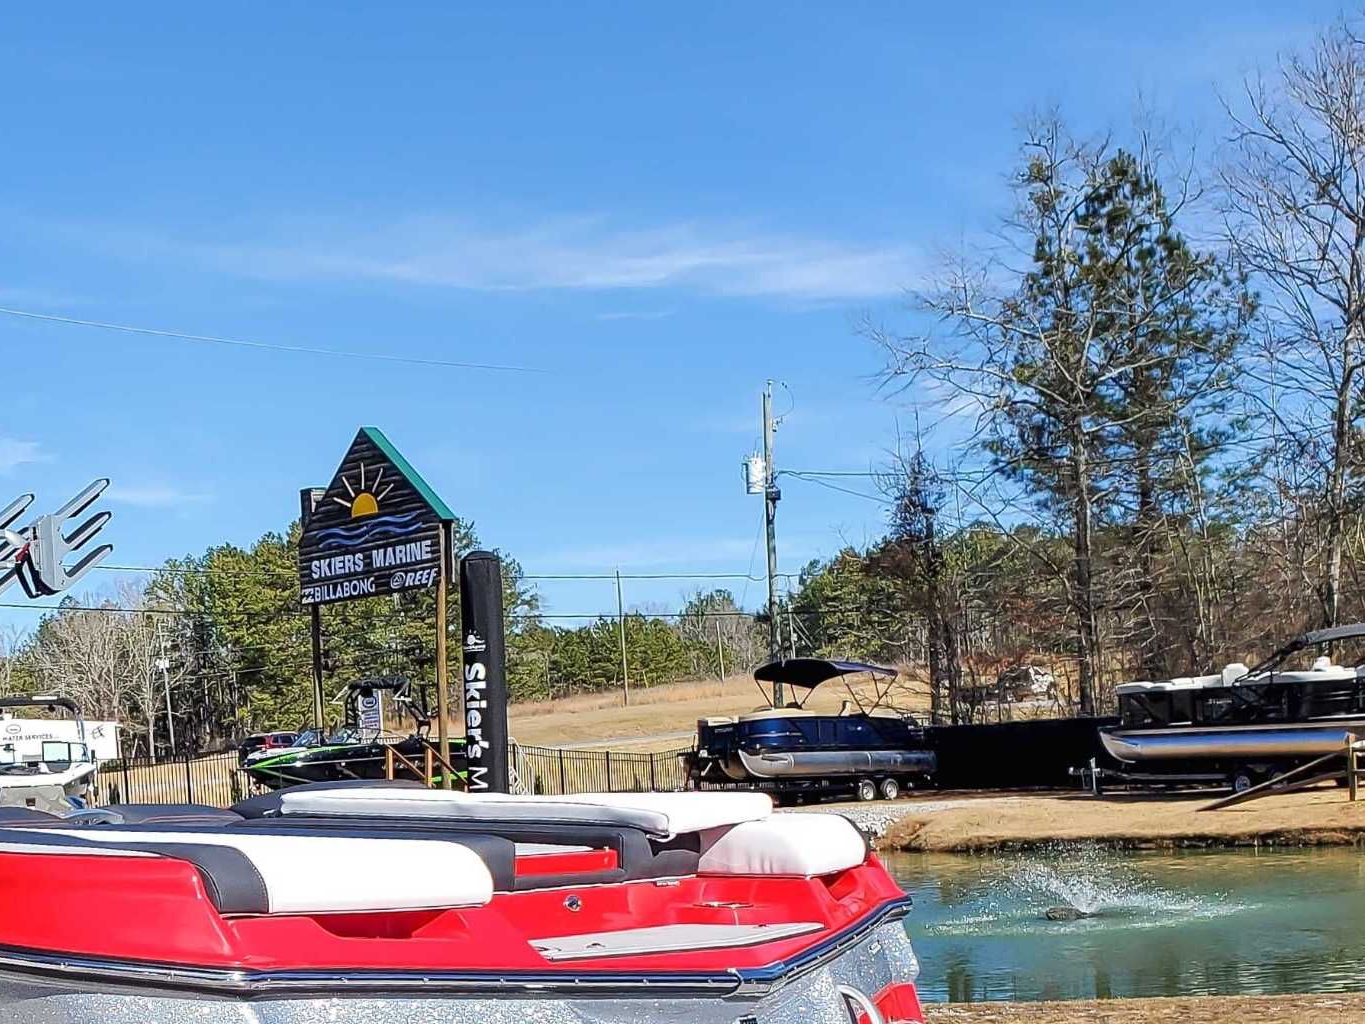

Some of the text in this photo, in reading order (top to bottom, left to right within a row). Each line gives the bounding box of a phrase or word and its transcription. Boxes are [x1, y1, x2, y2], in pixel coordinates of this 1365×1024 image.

[311, 540, 432, 579] SKIERS MARINE
[315, 577, 375, 602] BILLABONG
[404, 568, 439, 588] REEF
[465, 662, 490, 759] Skier's
